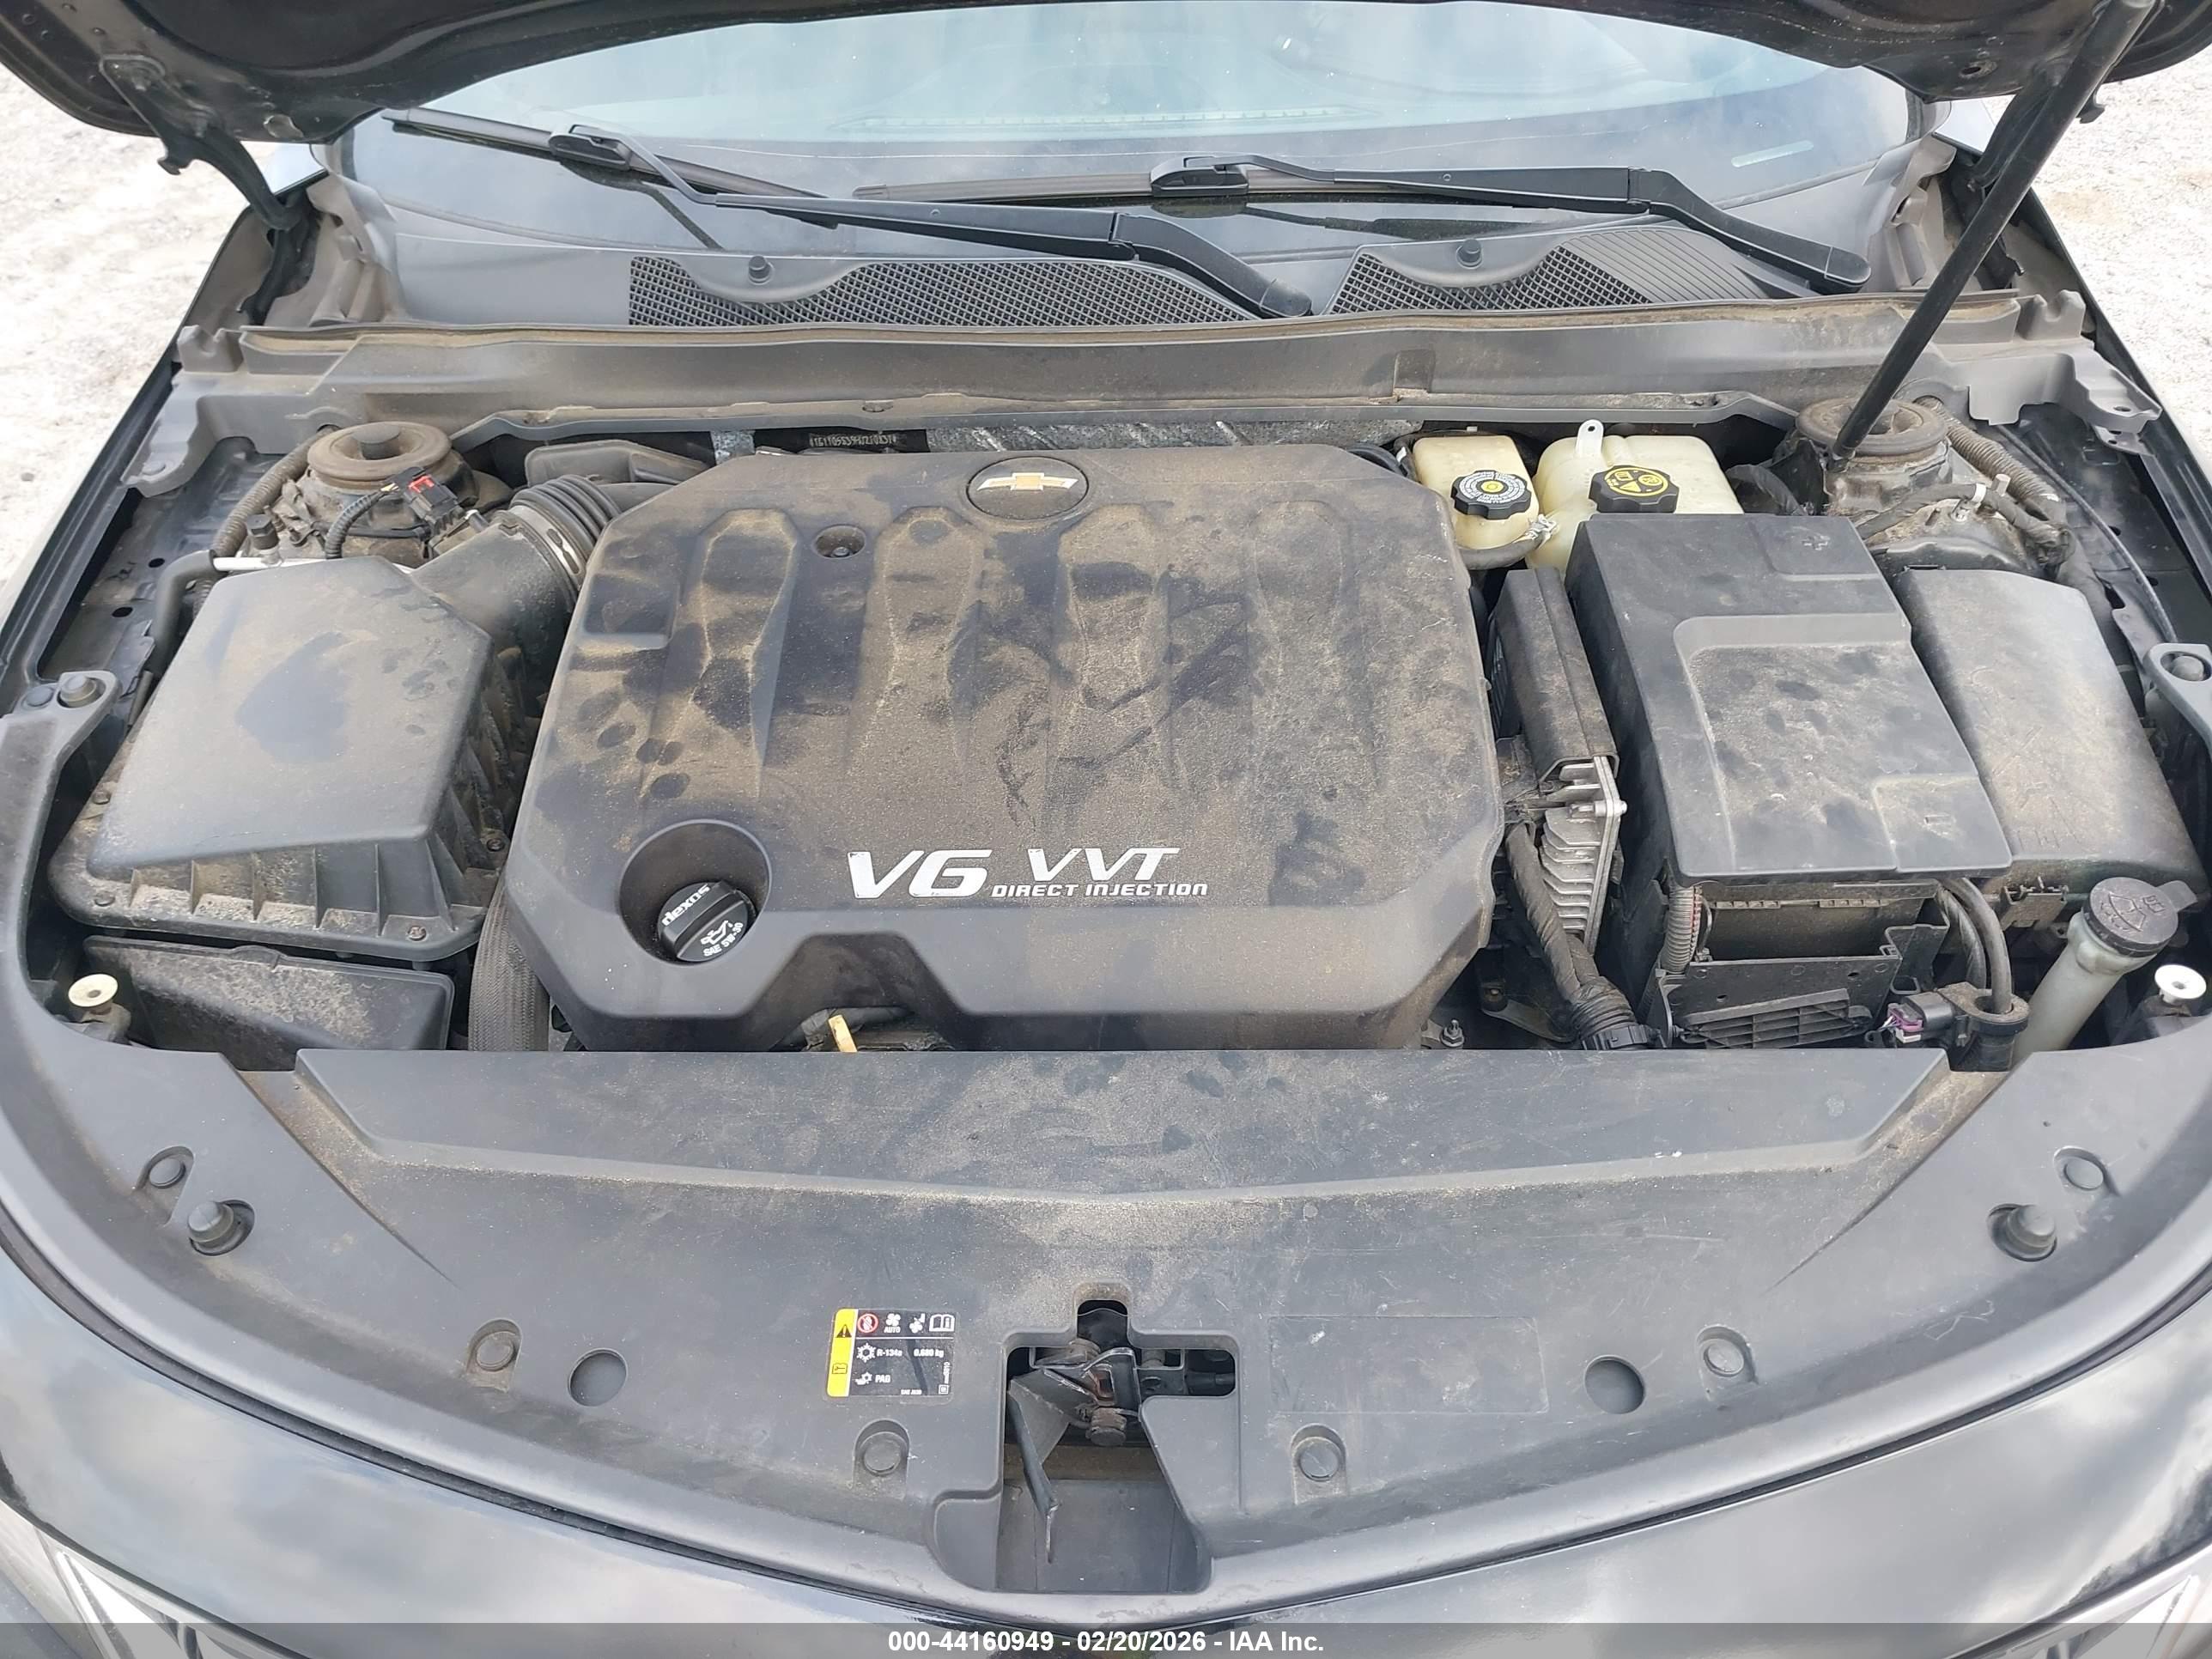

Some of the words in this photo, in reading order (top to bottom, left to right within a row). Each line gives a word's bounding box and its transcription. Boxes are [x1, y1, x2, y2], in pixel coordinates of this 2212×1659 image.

[848, 849, 992, 898] V6
[1028, 848, 1180, 881] VVT
[991, 883, 1079, 897] DIRECT
[1085, 883, 1209, 896] INJECTION
[661, 884, 711, 927] dexos
[702, 944, 722, 957] SAE
[720, 922, 744, 948] 5W-30
